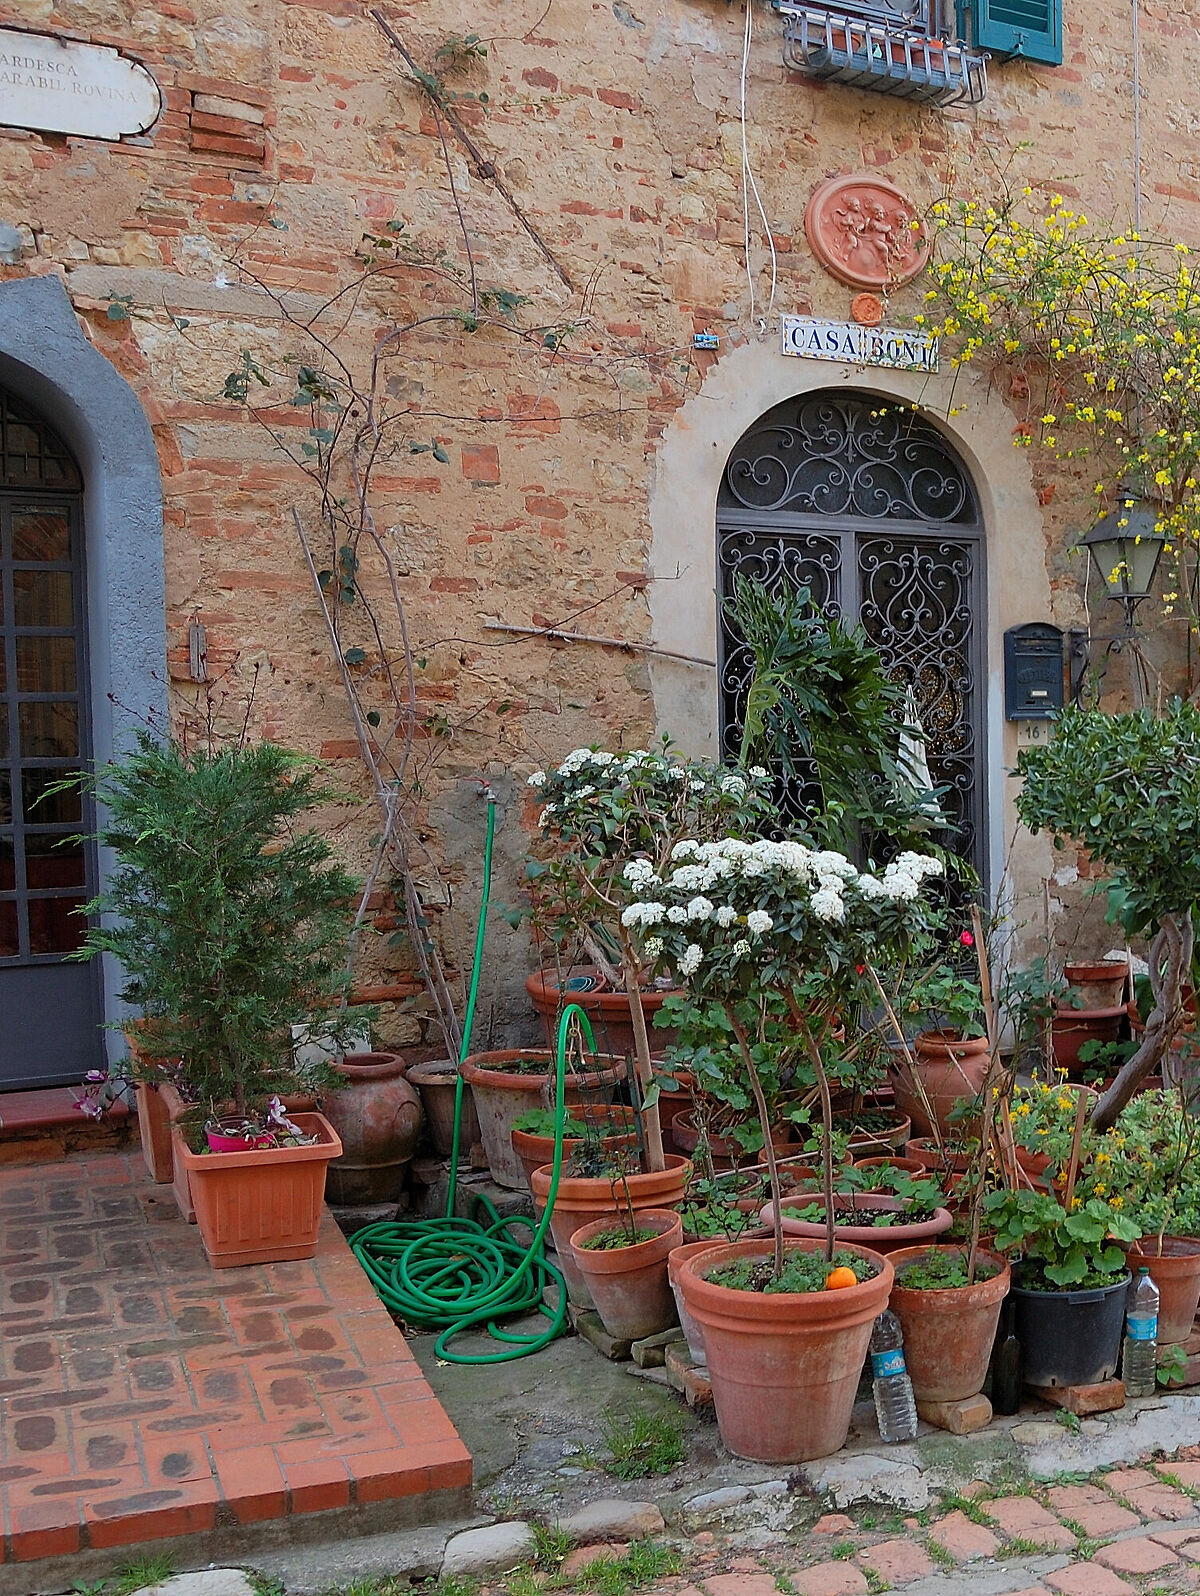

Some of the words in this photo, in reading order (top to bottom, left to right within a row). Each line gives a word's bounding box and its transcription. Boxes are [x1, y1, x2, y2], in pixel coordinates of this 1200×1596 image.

[72, 81, 138, 104] ROVINA
[791, 326, 857, 355] CASA
[871, 336, 927, 364] BONI
[1025, 725, 1040, 739] 16
